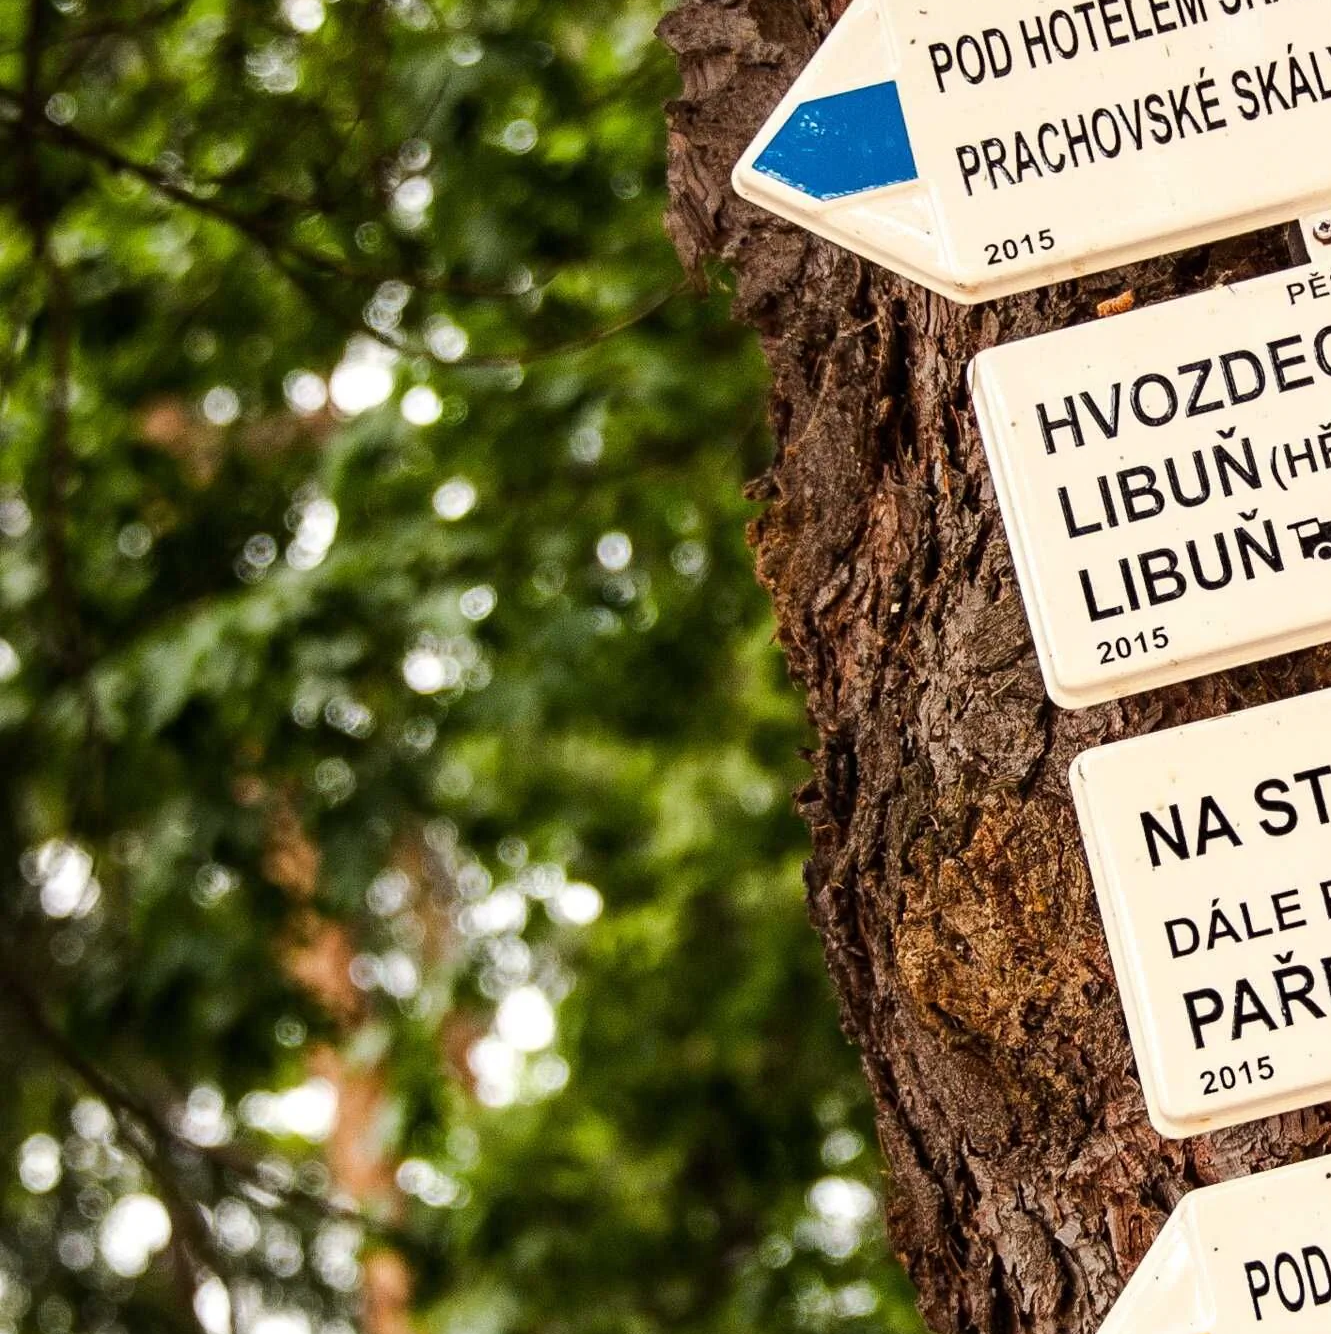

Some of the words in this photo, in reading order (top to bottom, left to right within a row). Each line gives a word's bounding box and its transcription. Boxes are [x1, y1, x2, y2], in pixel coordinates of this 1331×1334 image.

[927, 27, 1014, 95] POD
[954, 65, 1229, 198] PRACHOVSKÉ
[983, 227, 1056, 267] 2015
[1056, 425, 1264, 540] LIBUŇ
[1077, 506, 1286, 624] LIBUŇ
[1095, 625, 1170, 666] 2015
[1138, 794, 1245, 869] NA
[1162, 887, 1308, 960] DÁLE
[1198, 1054, 1276, 1097] 2015
